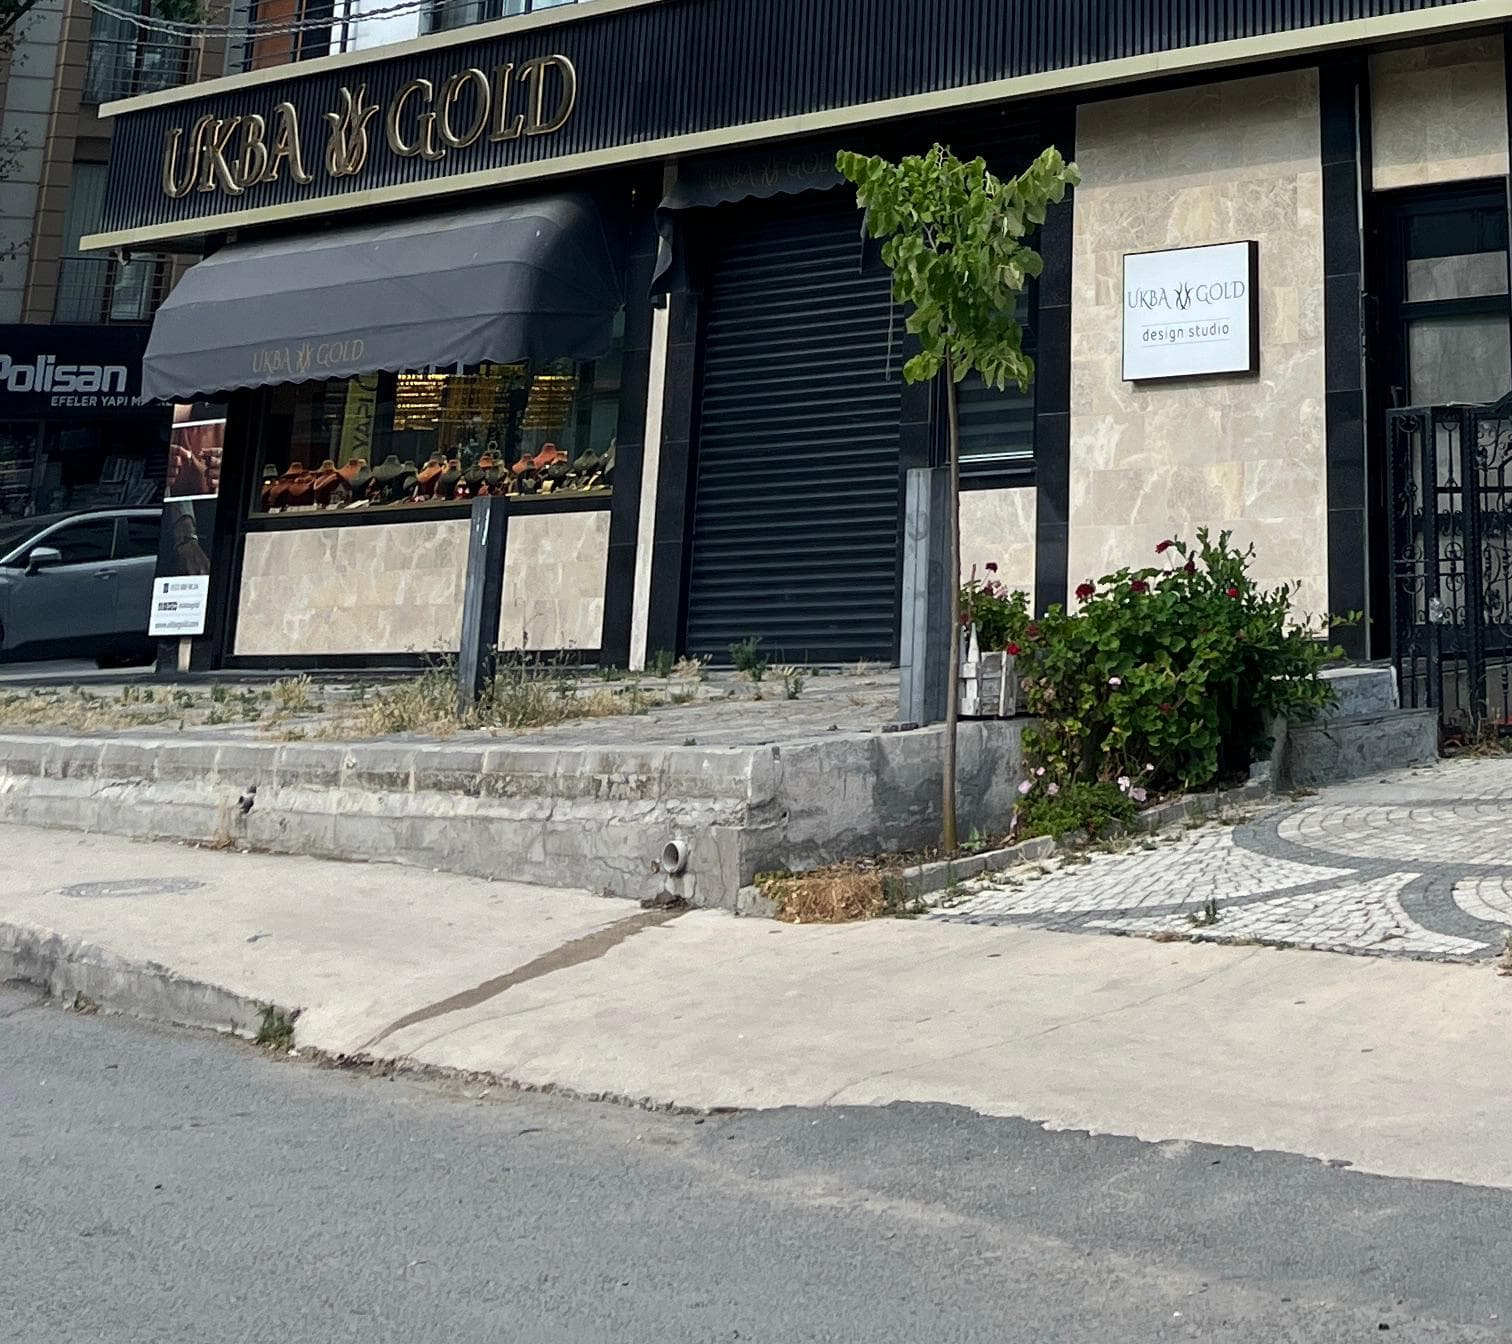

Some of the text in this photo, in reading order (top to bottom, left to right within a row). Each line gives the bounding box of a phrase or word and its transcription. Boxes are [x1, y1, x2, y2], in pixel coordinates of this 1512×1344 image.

[162, 54, 578, 199] UKBA GOLD
[1128, 280, 1245, 310] UKBA GOLD
[1142, 322, 1229, 343] design studio
[316, 339, 365, 368] GOLD
[51, 396, 97, 407] EFELER
[102, 395, 128, 407] YAPI
